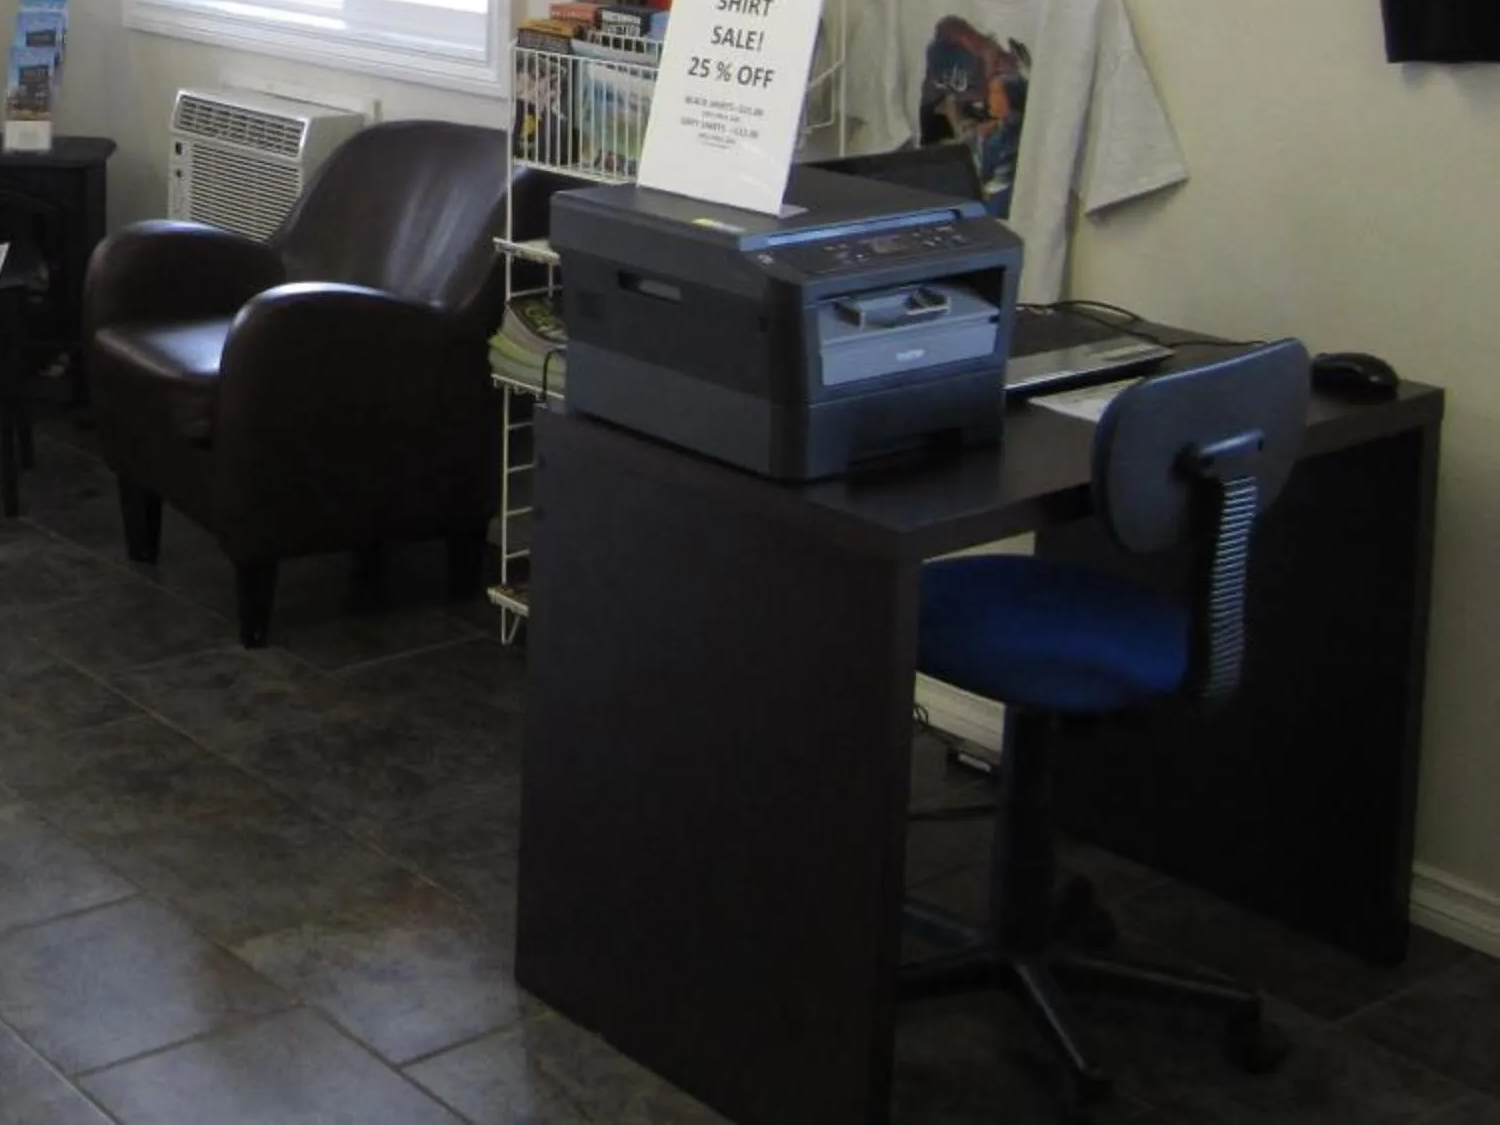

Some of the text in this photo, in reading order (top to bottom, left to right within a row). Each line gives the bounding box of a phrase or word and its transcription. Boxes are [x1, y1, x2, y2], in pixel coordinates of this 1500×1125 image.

[710, 26, 764, 52] SALE!
[688, 56, 775, 89] 25 % OFF
